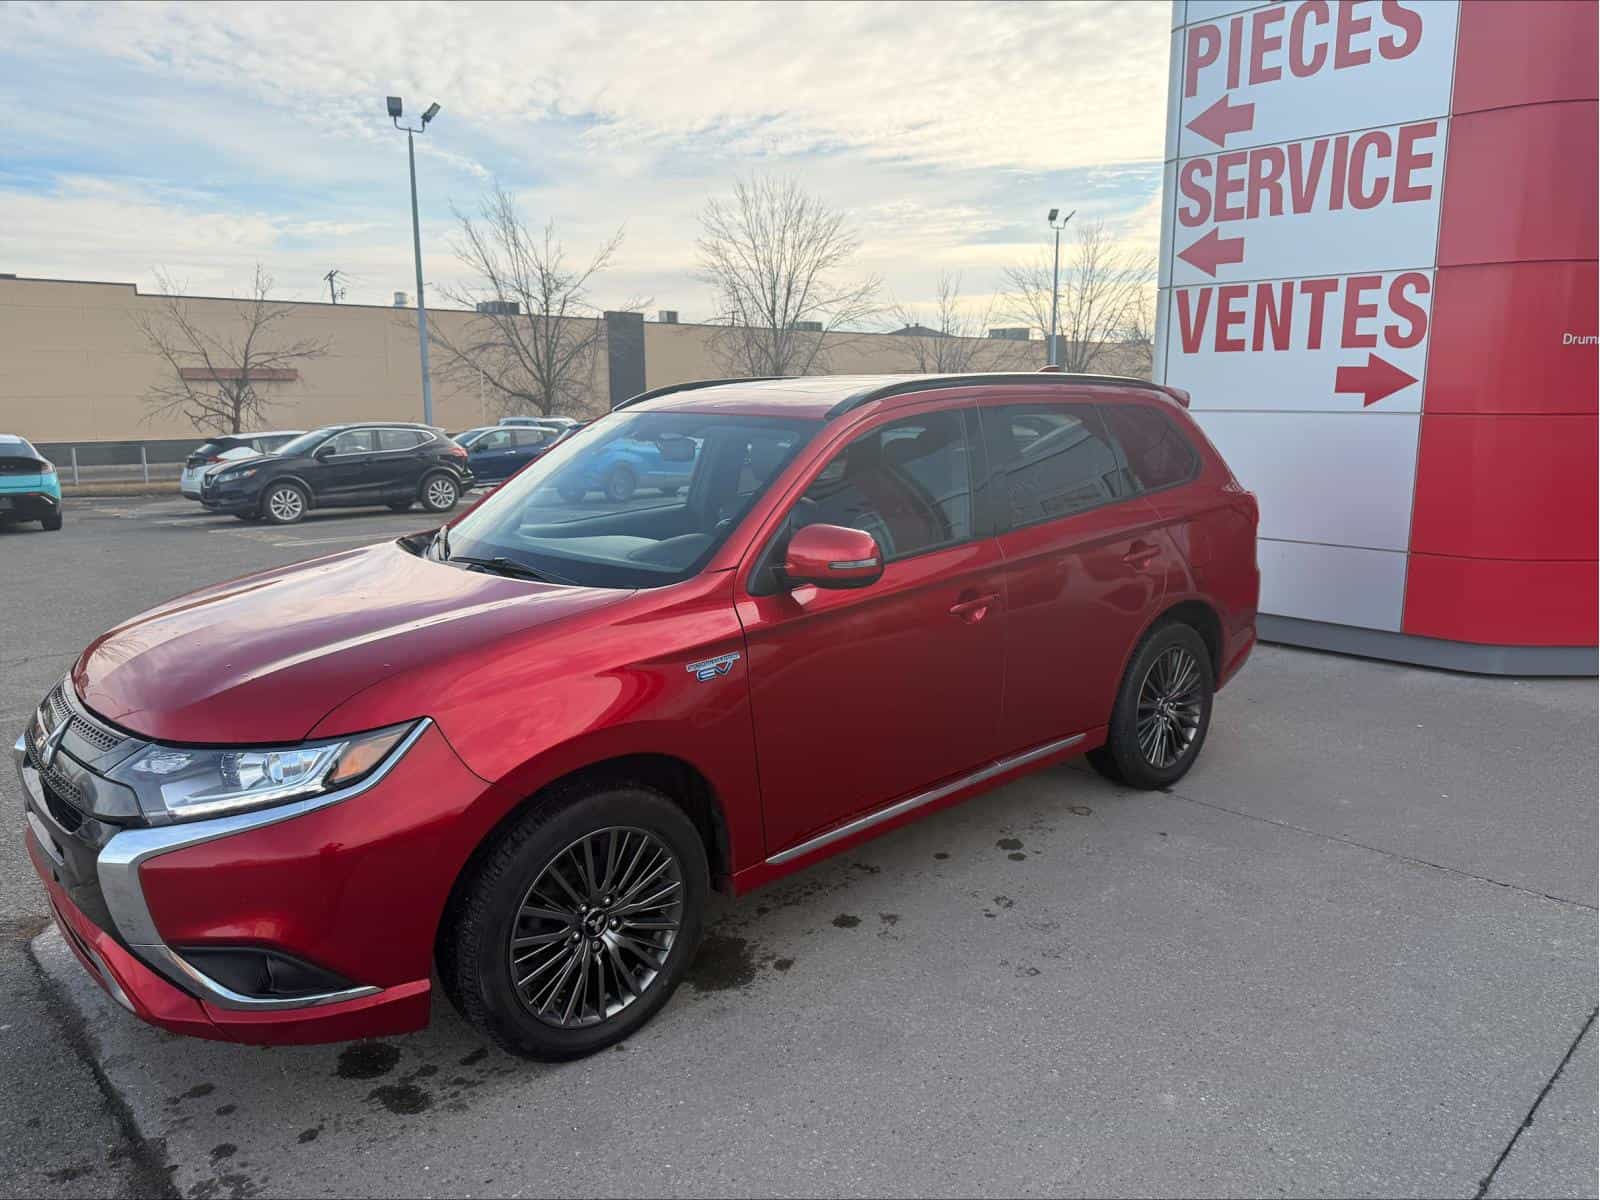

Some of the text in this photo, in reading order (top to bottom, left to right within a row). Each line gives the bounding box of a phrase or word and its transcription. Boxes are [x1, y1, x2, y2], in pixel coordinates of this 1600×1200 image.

[1178, 122, 1438, 227] SERVICE
[1176, 272, 1430, 353] VENTES
[1562, 332, 1599, 345] Drum
[697, 660, 733, 681] EV
